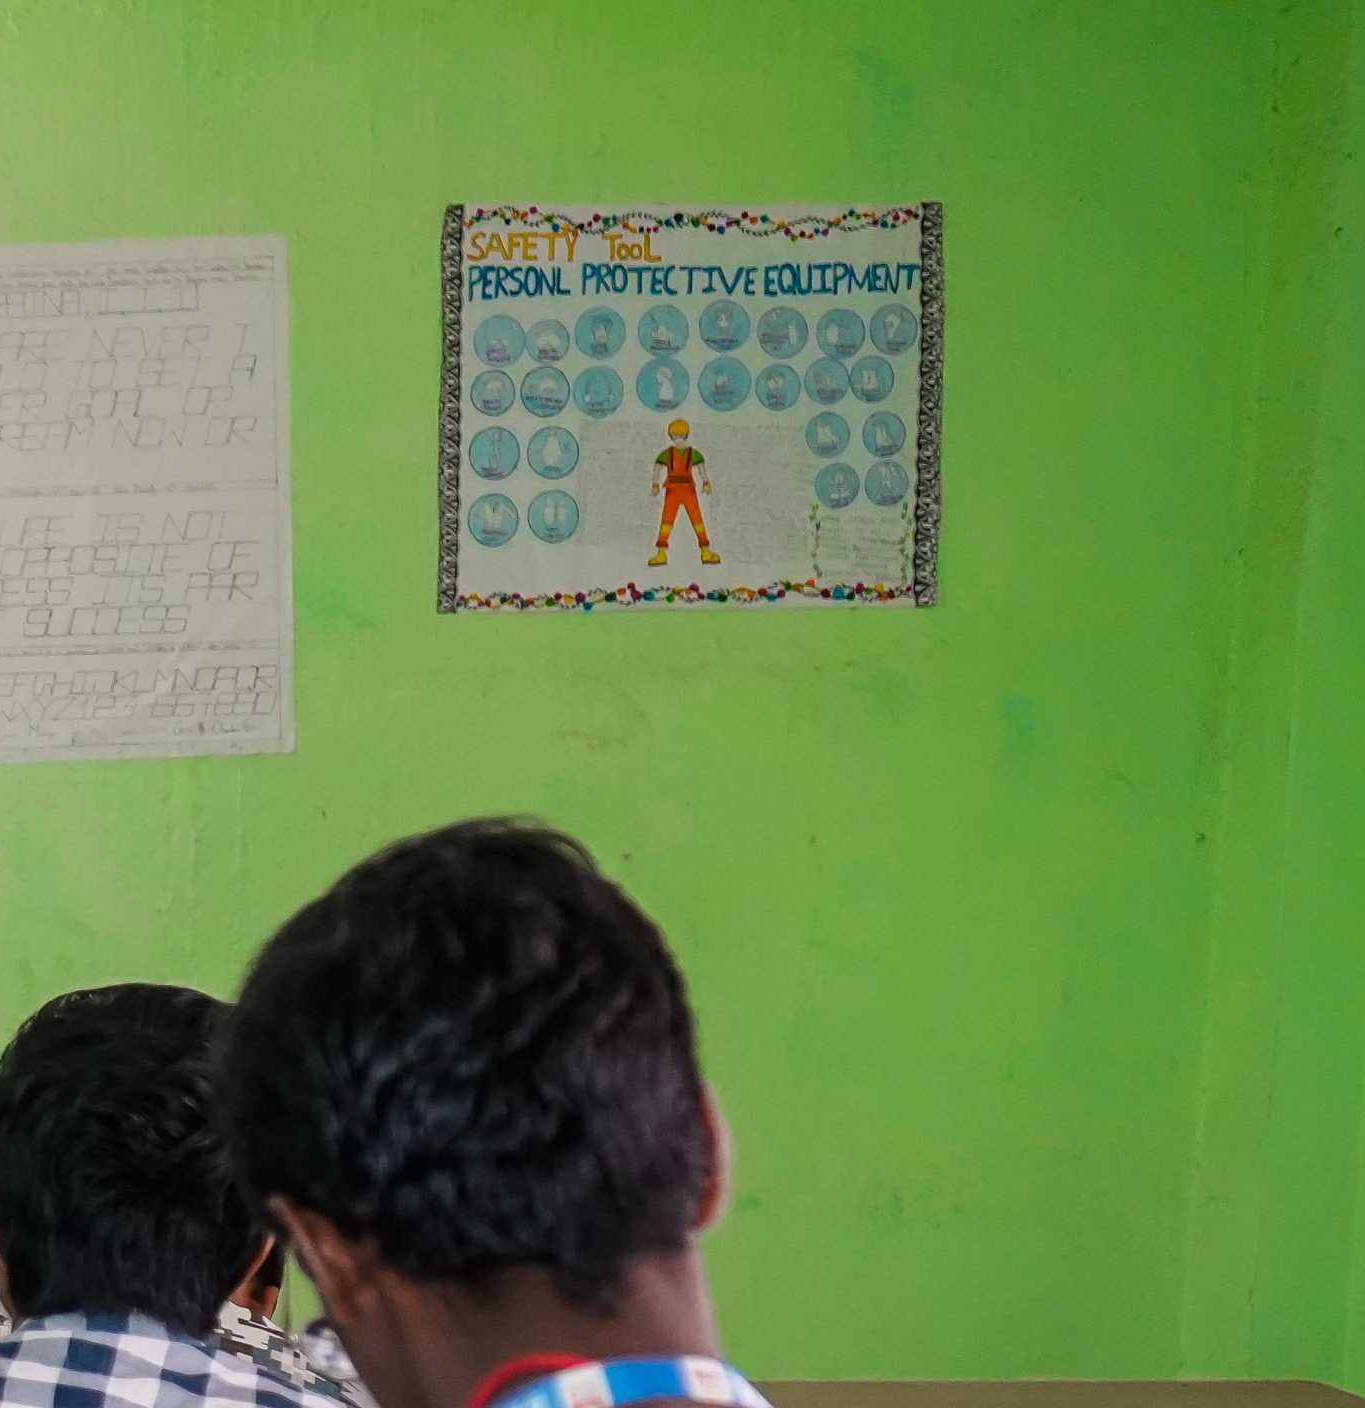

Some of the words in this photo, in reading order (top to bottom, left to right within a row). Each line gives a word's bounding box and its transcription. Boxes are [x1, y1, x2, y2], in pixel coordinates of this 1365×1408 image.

[467, 230, 579, 263] SAFETY
[469, 265, 570, 301] PERSONL
[582, 263, 758, 296] PROTECTIVE
[763, 261, 920, 297] EQUIPMENT
